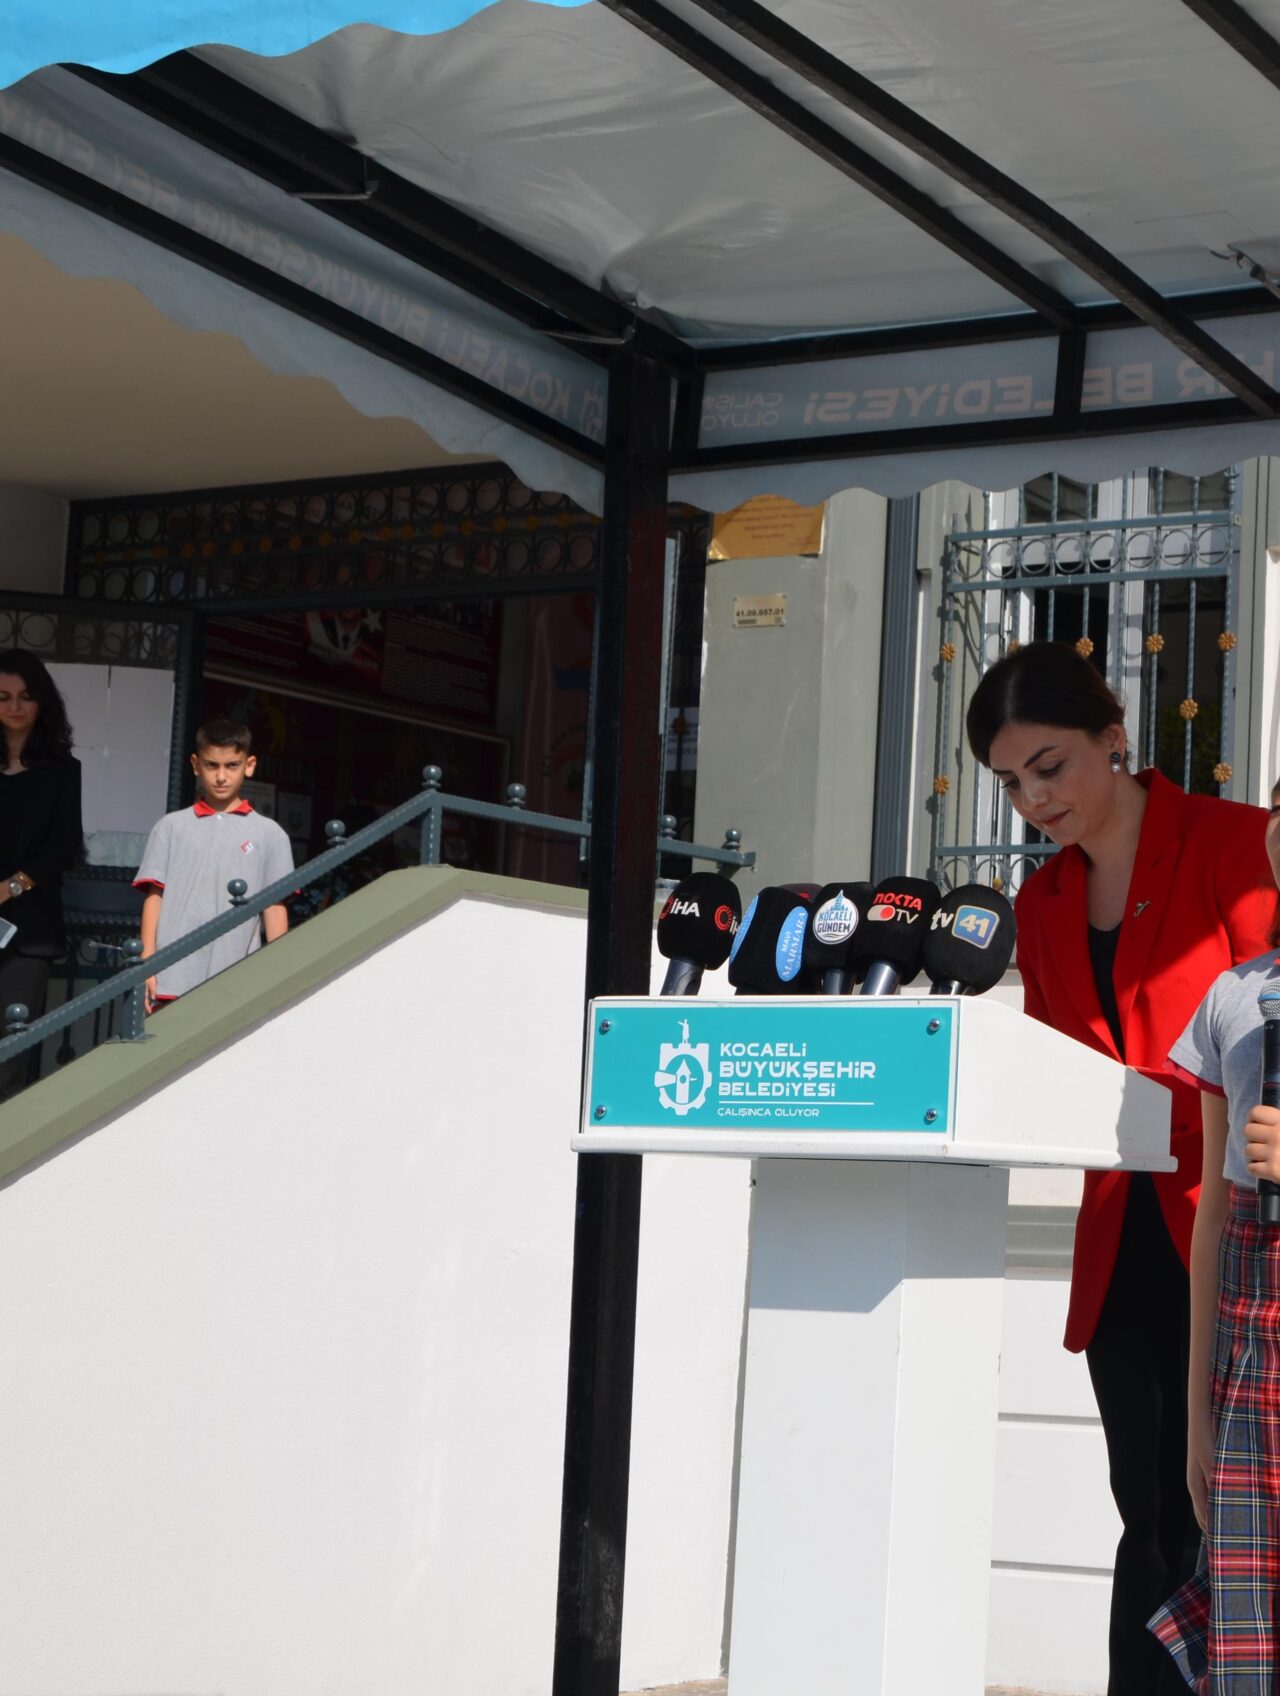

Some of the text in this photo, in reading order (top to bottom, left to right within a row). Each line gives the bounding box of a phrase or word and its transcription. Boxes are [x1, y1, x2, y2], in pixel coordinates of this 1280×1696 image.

[670, 898, 700, 917] İHA
[896, 908, 919, 924] TV
[817, 922, 850, 932] GÜNDEM
[959, 914, 990, 938] 41
[782, 912, 806, 977] MARMARA
[717, 1107, 820, 1117] ÇALIŞINCA OLUYOR
